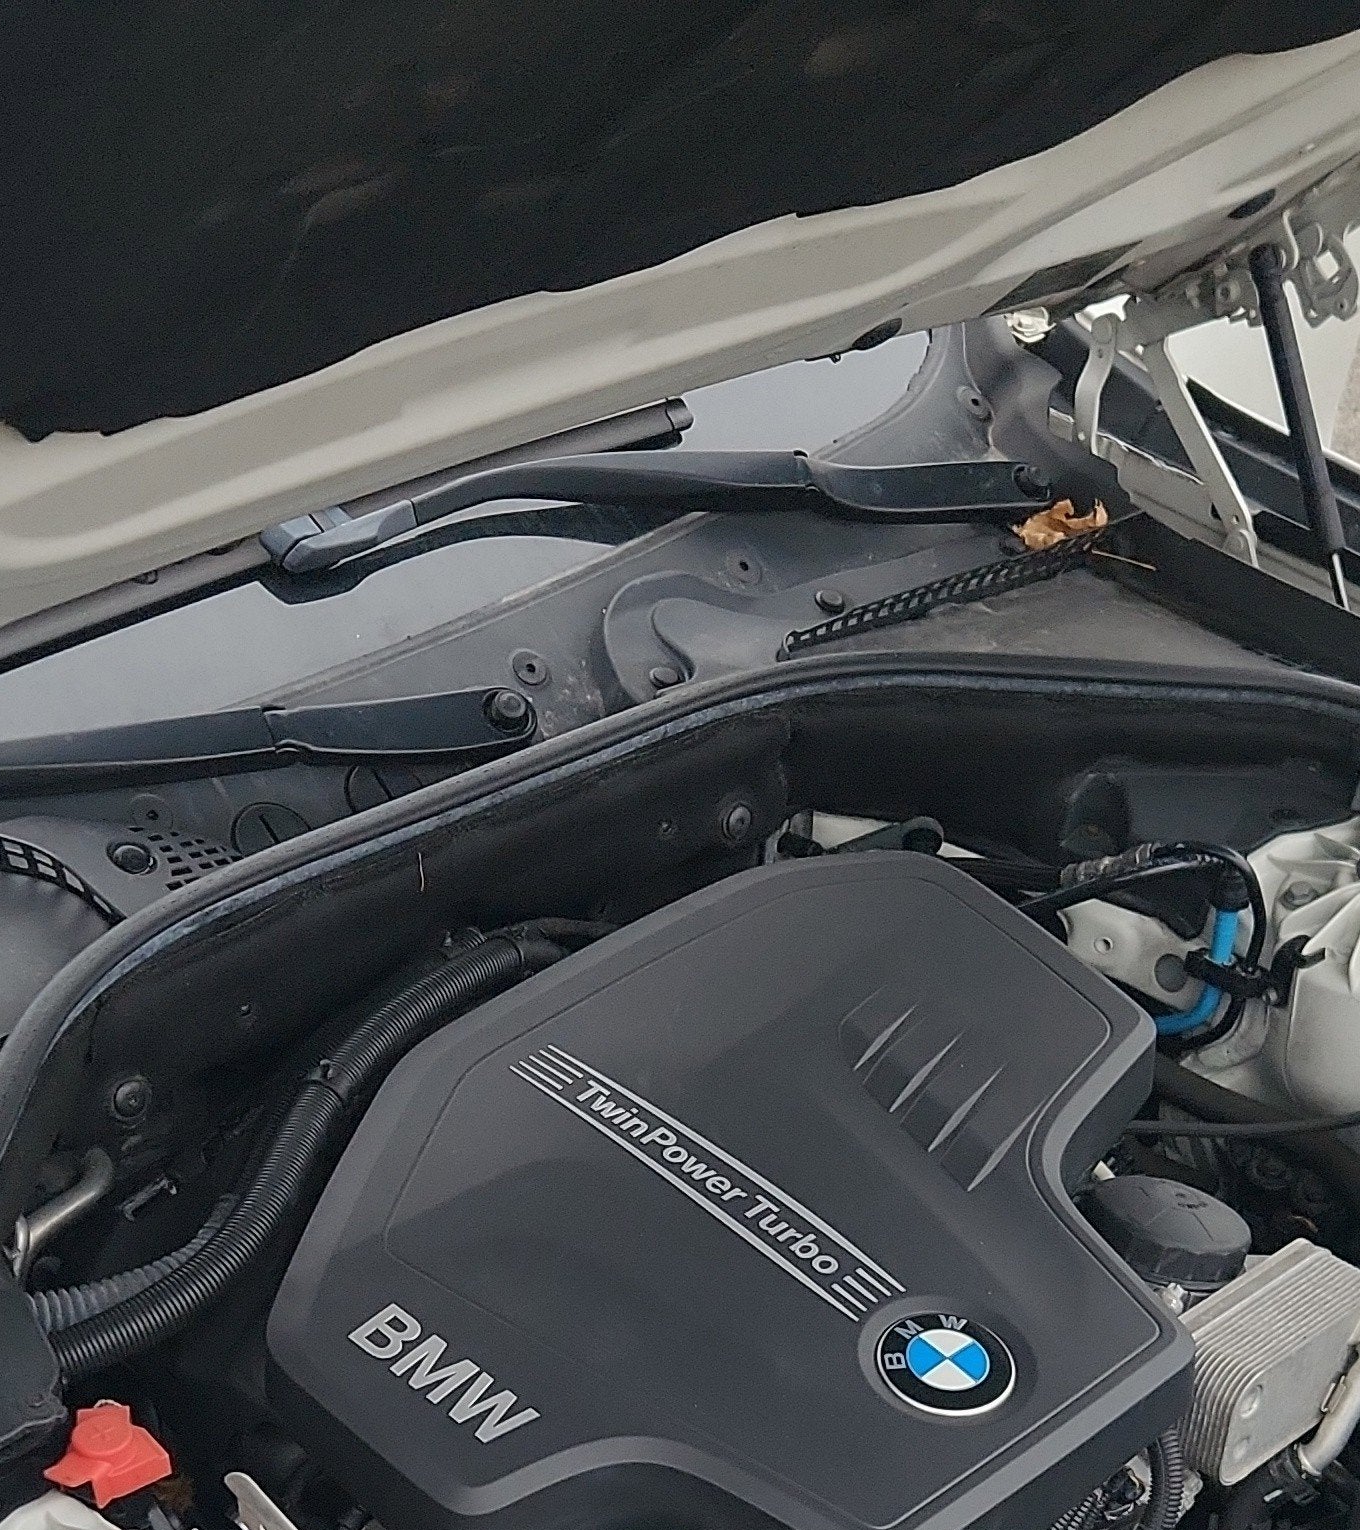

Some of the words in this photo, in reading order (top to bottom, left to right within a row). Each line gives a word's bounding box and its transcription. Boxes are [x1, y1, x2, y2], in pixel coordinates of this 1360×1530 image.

[576, 1080, 748, 1202] TwinPower
[743, 1194, 840, 1275] Turbo
[348, 1302, 541, 1444] BMW
[883, 1314, 969, 1370] BMW
